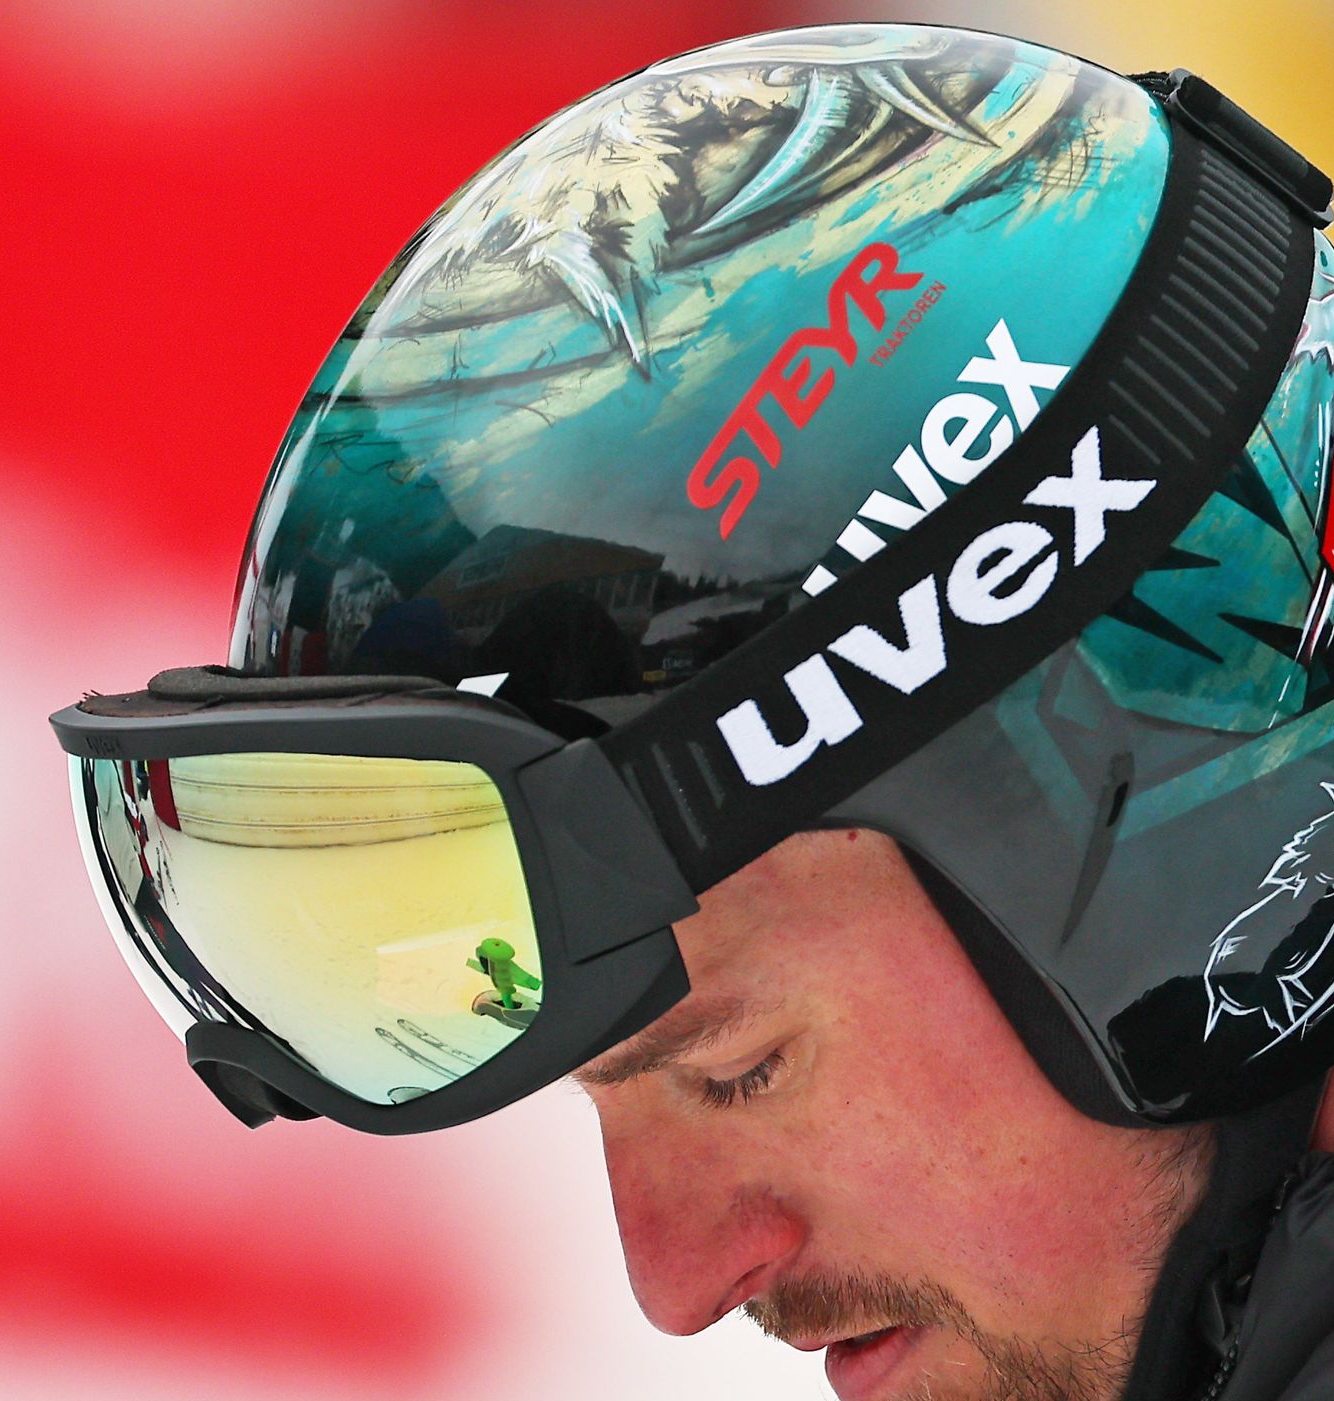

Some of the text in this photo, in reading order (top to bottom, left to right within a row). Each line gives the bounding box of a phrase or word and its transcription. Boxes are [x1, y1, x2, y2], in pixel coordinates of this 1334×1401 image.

[686, 241, 924, 541] STEYR
[869, 280, 947, 369] TRAKTOREN
[716, 425, 1157, 787] uvex
